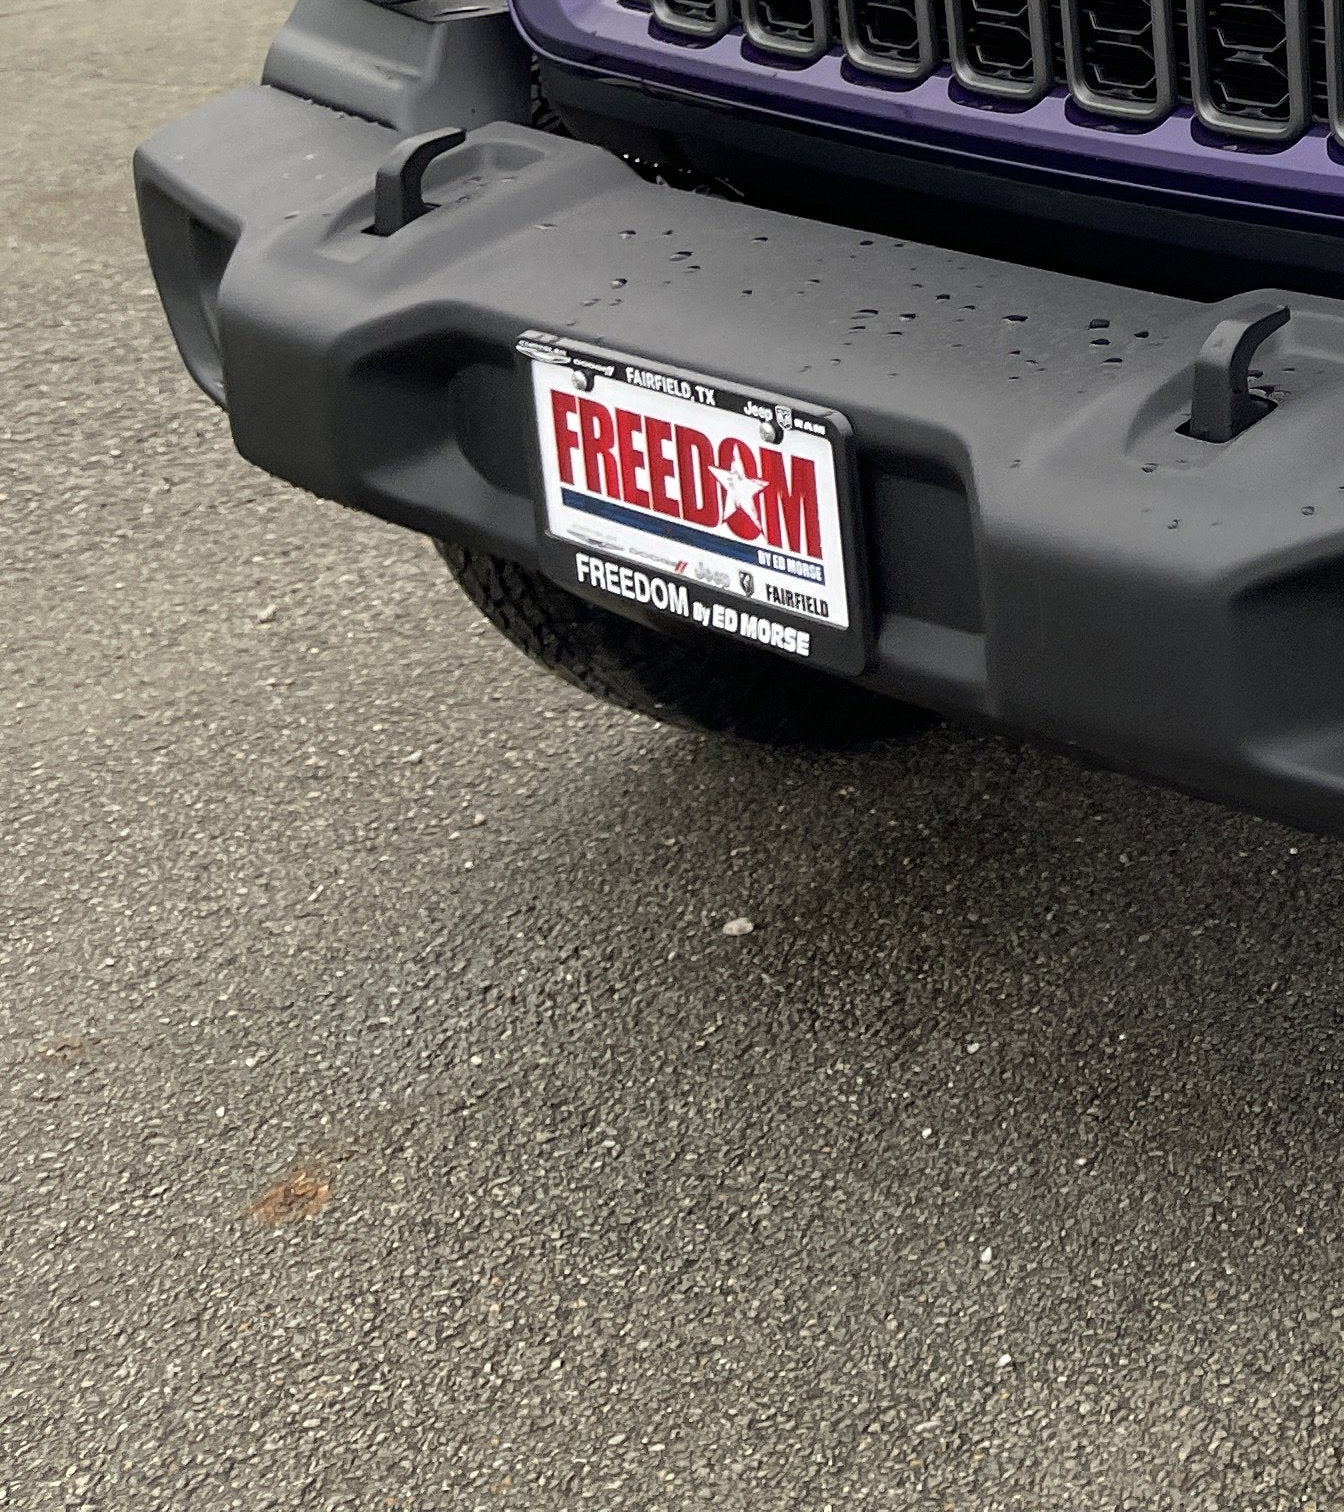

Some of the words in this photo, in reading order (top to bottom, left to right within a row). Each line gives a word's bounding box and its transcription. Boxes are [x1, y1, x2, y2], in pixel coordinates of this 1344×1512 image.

[625, 366, 695, 402] FAIRFIELD,
[695, 385, 716, 406] TX
[743, 401, 773, 422] Jeep
[550, 388, 823, 560] FREEDOM
[772, 554, 786, 571] ED
[786, 558, 823, 581] MORSE
[575, 552, 690, 618] FREEDOM
[712, 604, 739, 634] ED
[740, 613, 811, 657] MORSE
[765, 583, 829, 618] FAIRFIELD
